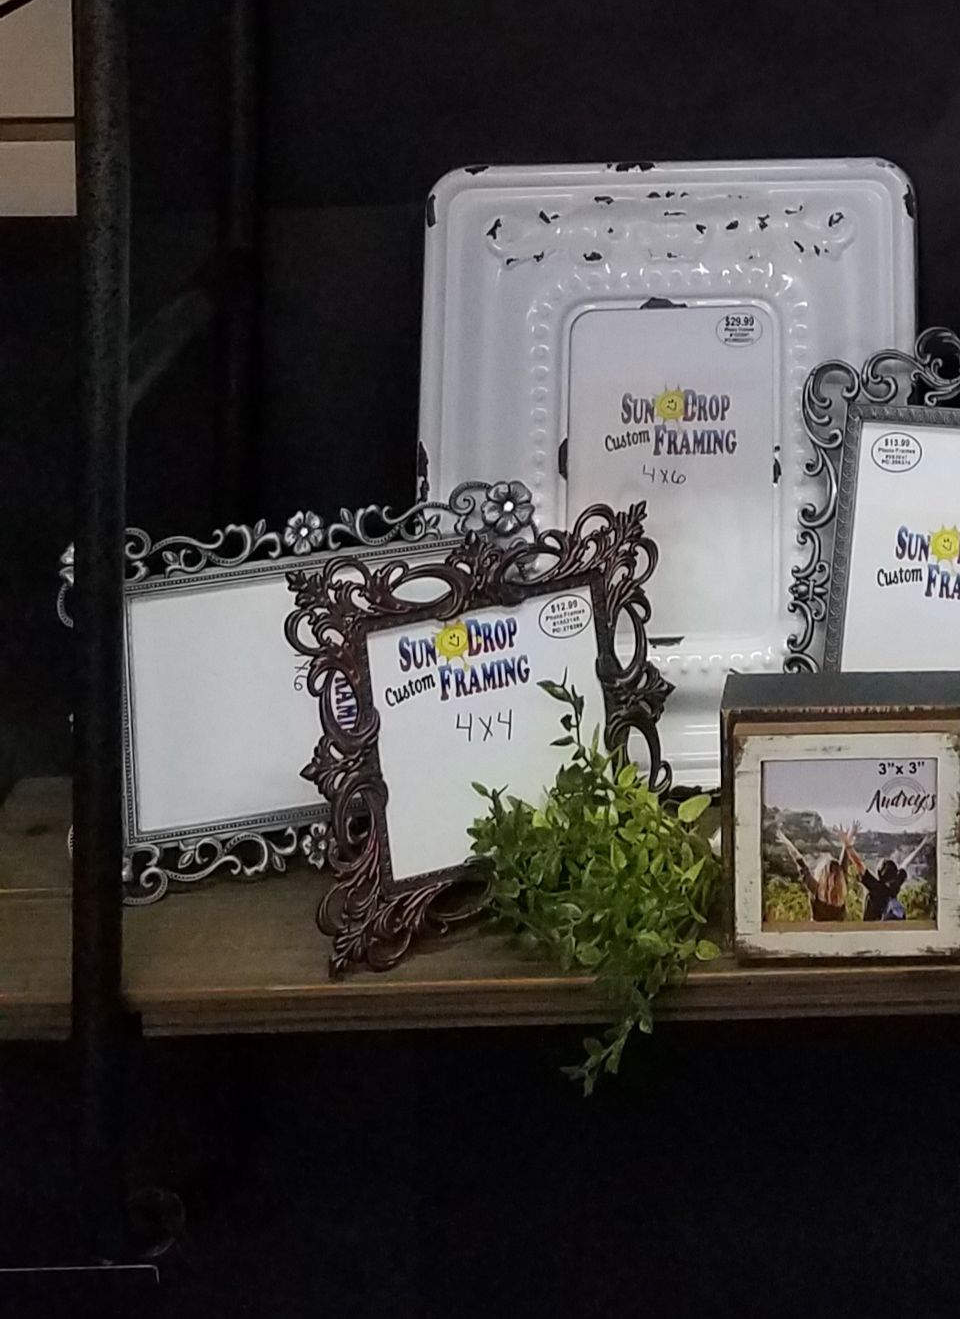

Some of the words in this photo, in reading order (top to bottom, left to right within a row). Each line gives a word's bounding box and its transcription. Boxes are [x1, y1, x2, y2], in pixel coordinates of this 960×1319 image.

[725, 315, 754, 327] $29.99
[621, 392, 655, 424] SUN
[683, 389, 730, 422] DROP
[605, 430, 650, 452] Custom
[653, 425, 737, 456] FRAMING
[895, 525, 931, 562] SUN
[877, 567, 922, 587] Custom
[398, 636, 438, 672] SUN
[466, 618, 517, 657] DROP
[385, 674, 436, 707] Custom
[438, 654, 531, 701] FRAMING
[335, 677, 357, 726] RAMI
